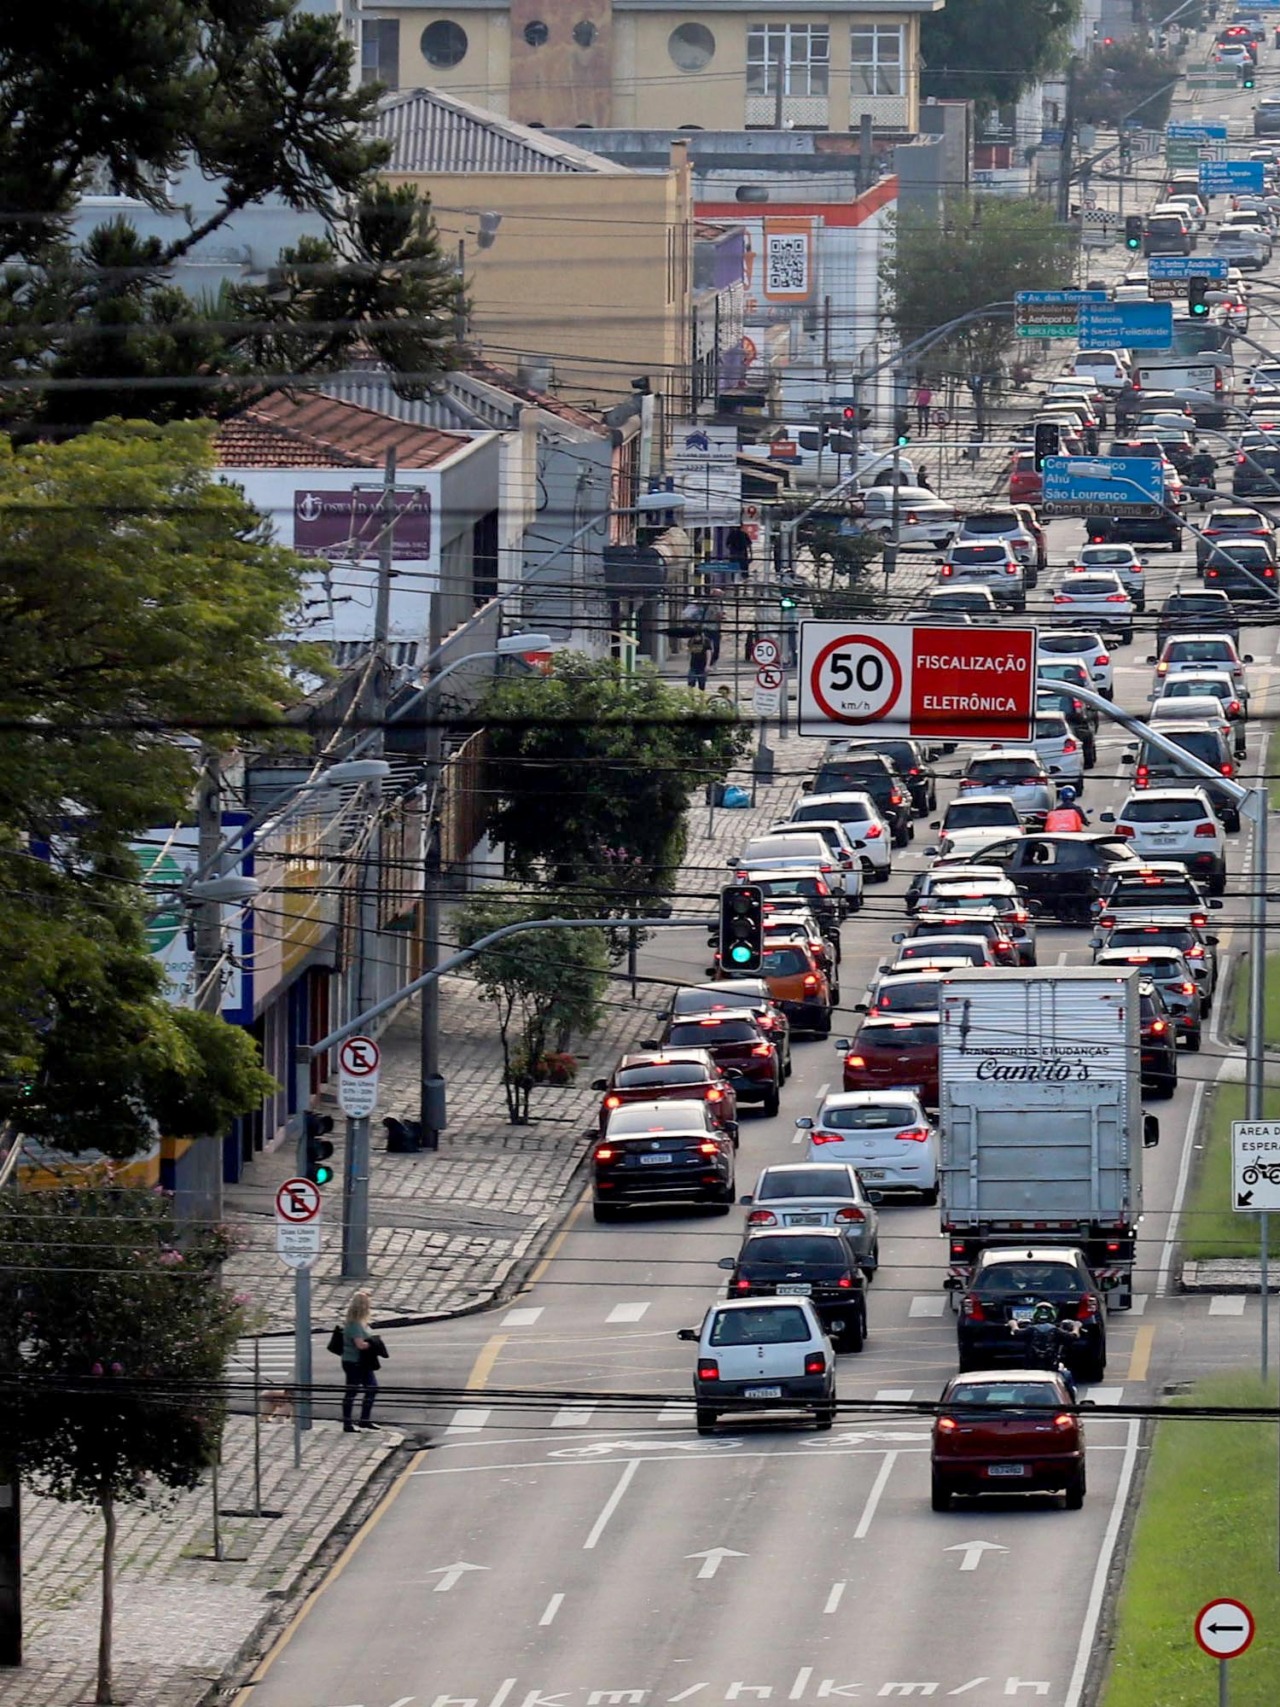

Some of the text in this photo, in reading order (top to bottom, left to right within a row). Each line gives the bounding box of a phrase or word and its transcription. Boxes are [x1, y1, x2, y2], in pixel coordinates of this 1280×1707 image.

[1046, 474, 1070, 484] Ahú
[1046, 488, 1068, 499] São
[757, 645, 774, 657] 50
[916, 653, 1027, 674] FISCALIZAÇÃO
[830, 653, 883, 692] 50
[841, 701, 871, 711] km/h
[923, 693, 1017, 711] ELETRÔNICA
[1240, 1124, 1270, 1136] ÁREA
